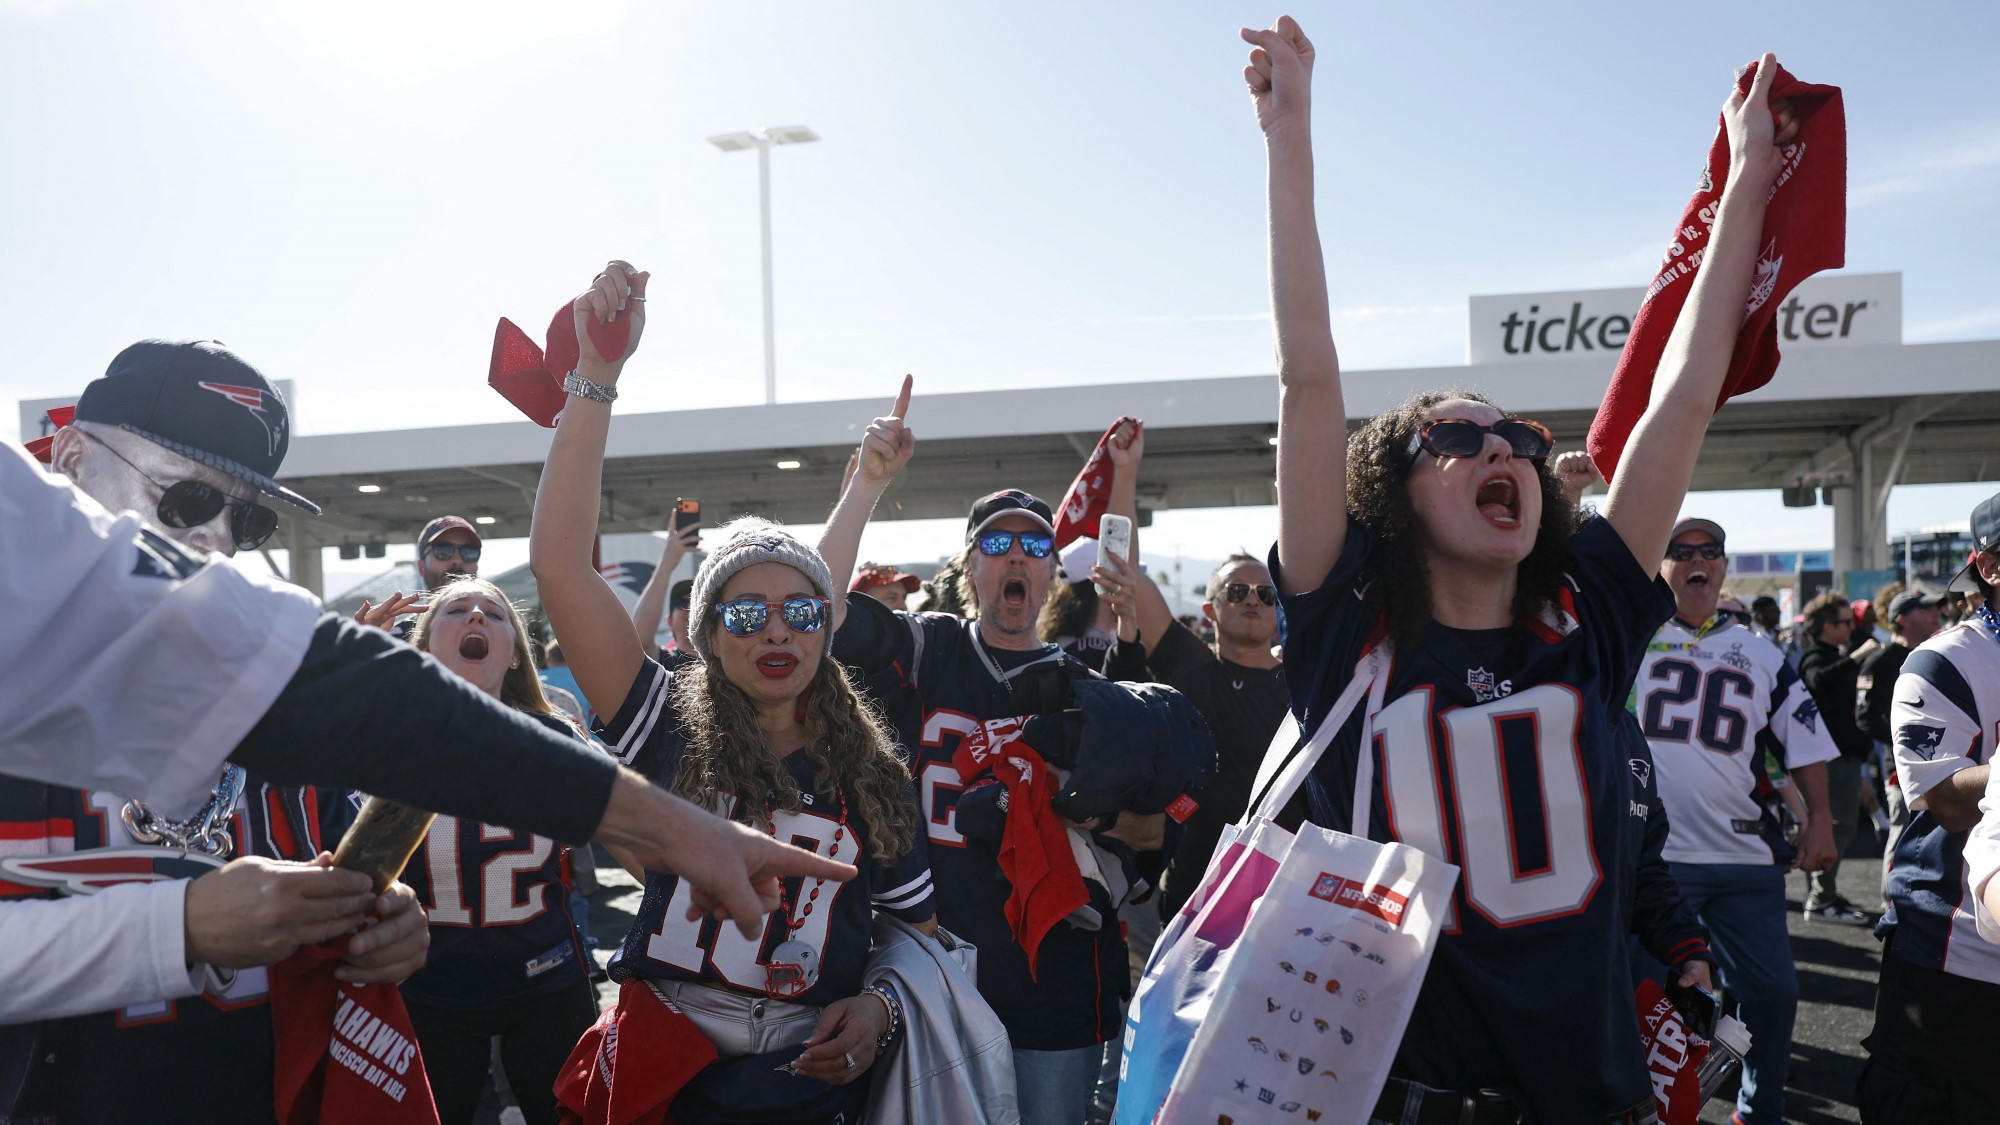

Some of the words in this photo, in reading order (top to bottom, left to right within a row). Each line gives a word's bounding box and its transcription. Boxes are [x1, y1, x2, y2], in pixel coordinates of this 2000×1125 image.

[1644, 656, 1755, 758] 26
[1371, 683, 1604, 935] 10
[423, 812, 553, 928] 12
[1367, 892, 1404, 916] SHOP
[333, 990, 416, 1076] AHAWKS
[363, 1064, 388, 1088] BAY
[382, 1077, 407, 1103] AREA
